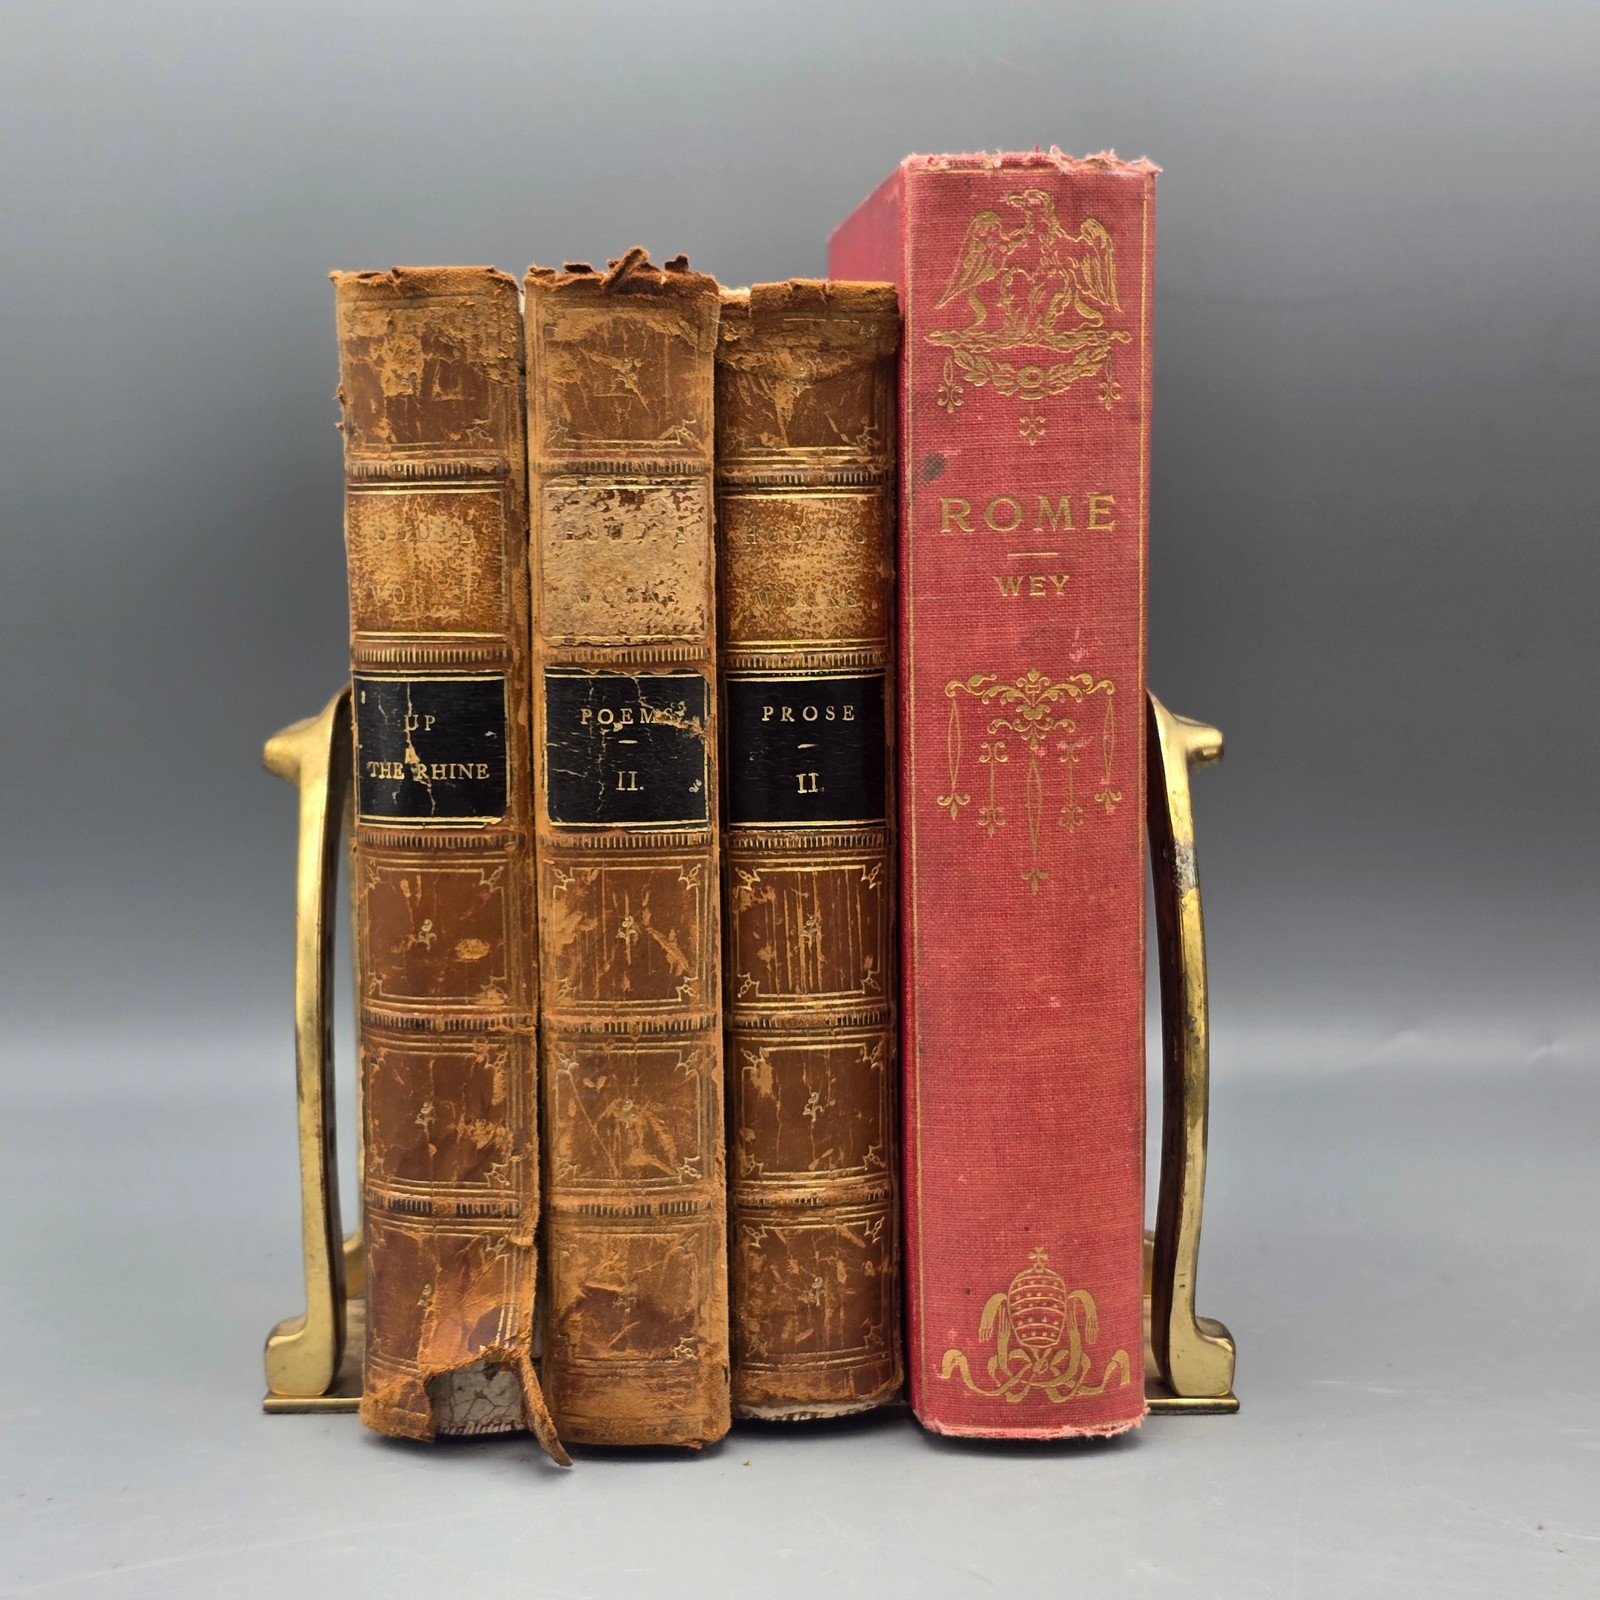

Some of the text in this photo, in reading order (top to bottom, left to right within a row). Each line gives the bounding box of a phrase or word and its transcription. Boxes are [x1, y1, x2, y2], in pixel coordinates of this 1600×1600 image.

[939, 491, 1116, 533] ROME
[993, 575, 1070, 597] WEY
[403, 714, 437, 732] UP
[580, 708, 674, 726] POEMS
[761, 705, 856, 722] PROSE
[366, 760, 490, 781] THE RHINE
